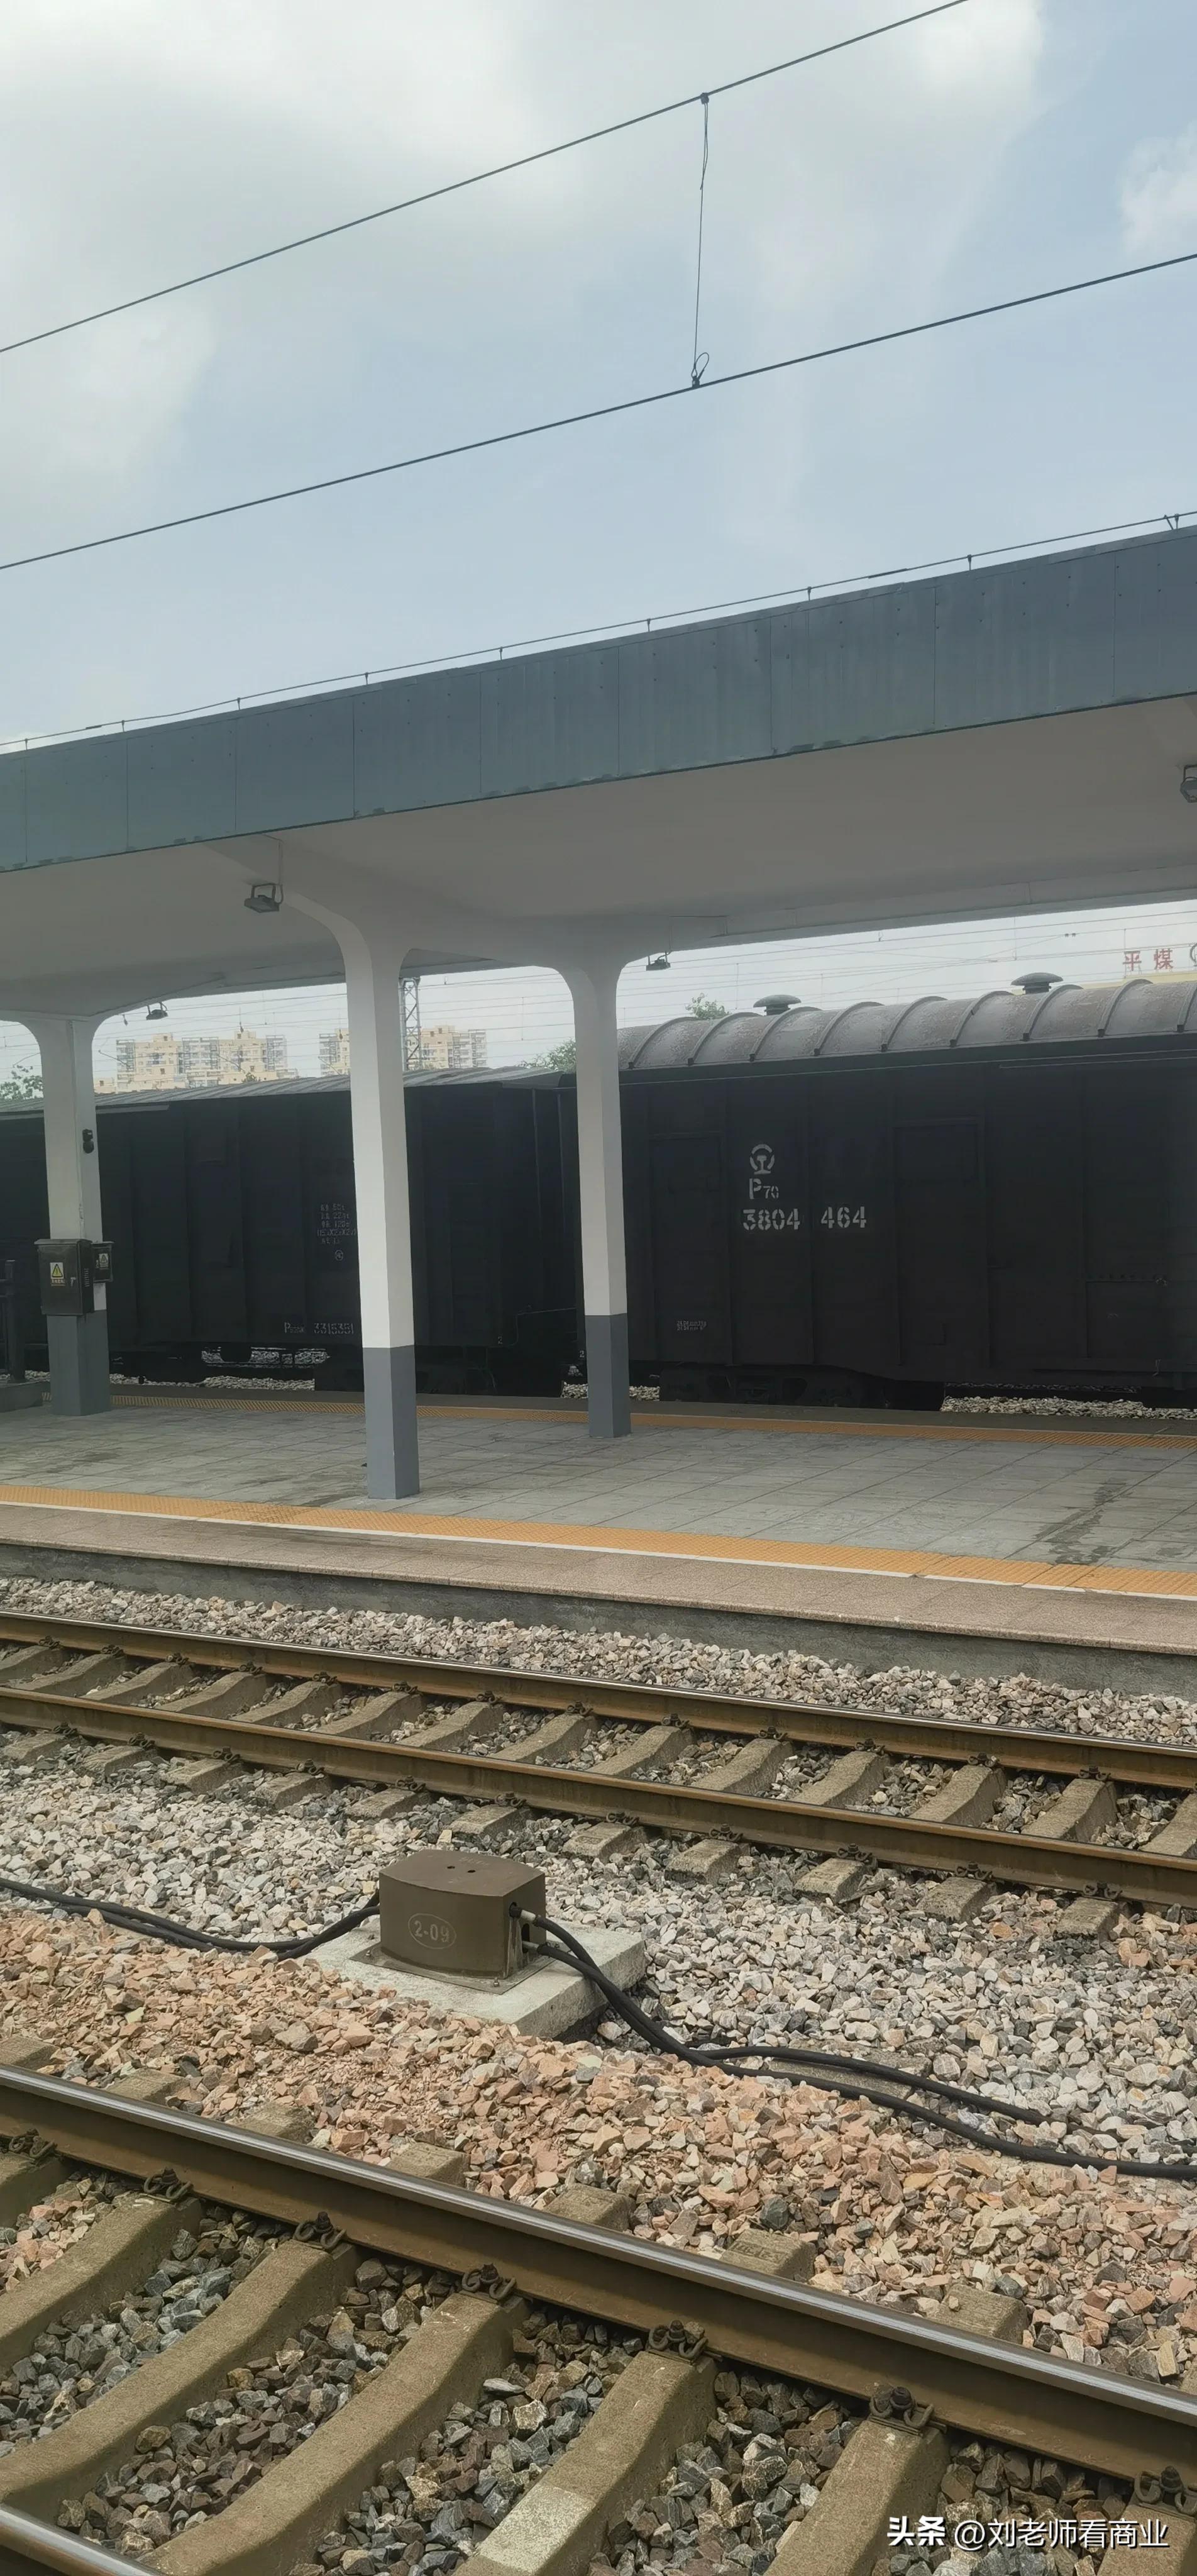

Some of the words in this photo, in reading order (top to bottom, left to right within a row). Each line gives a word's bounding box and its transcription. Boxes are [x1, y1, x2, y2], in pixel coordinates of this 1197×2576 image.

[1123, 948, 1174, 972] 平煤
[749, 1178, 780, 1200] P70
[742, 1208, 800, 1231] 3804
[821, 1206, 867, 1229] 464
[414, 1919, 451, 1943] 2-09
